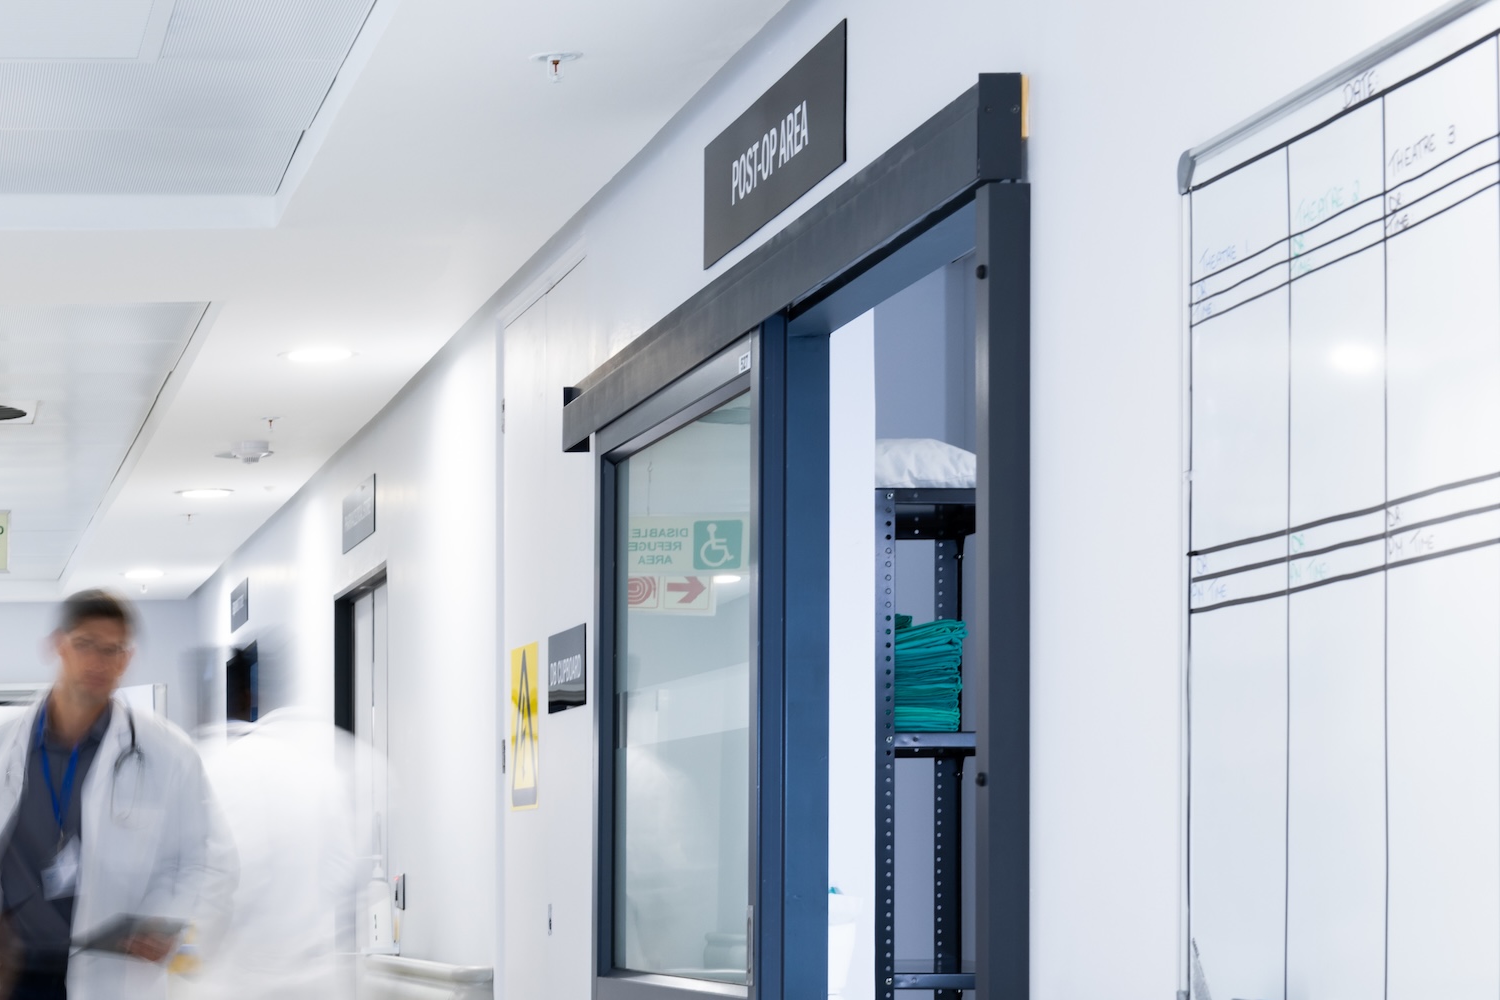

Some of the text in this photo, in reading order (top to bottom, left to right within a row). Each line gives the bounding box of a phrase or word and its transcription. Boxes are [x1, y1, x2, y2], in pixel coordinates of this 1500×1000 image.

[731, 100, 809, 207] POST-OP AREA
[1388, 124, 1456, 176] THEATRE 3
[1295, 186, 1343, 225] THEATRE
[1199, 245, 1236, 271] THEATRE
[558, 654, 581, 684] CUPBOARD
